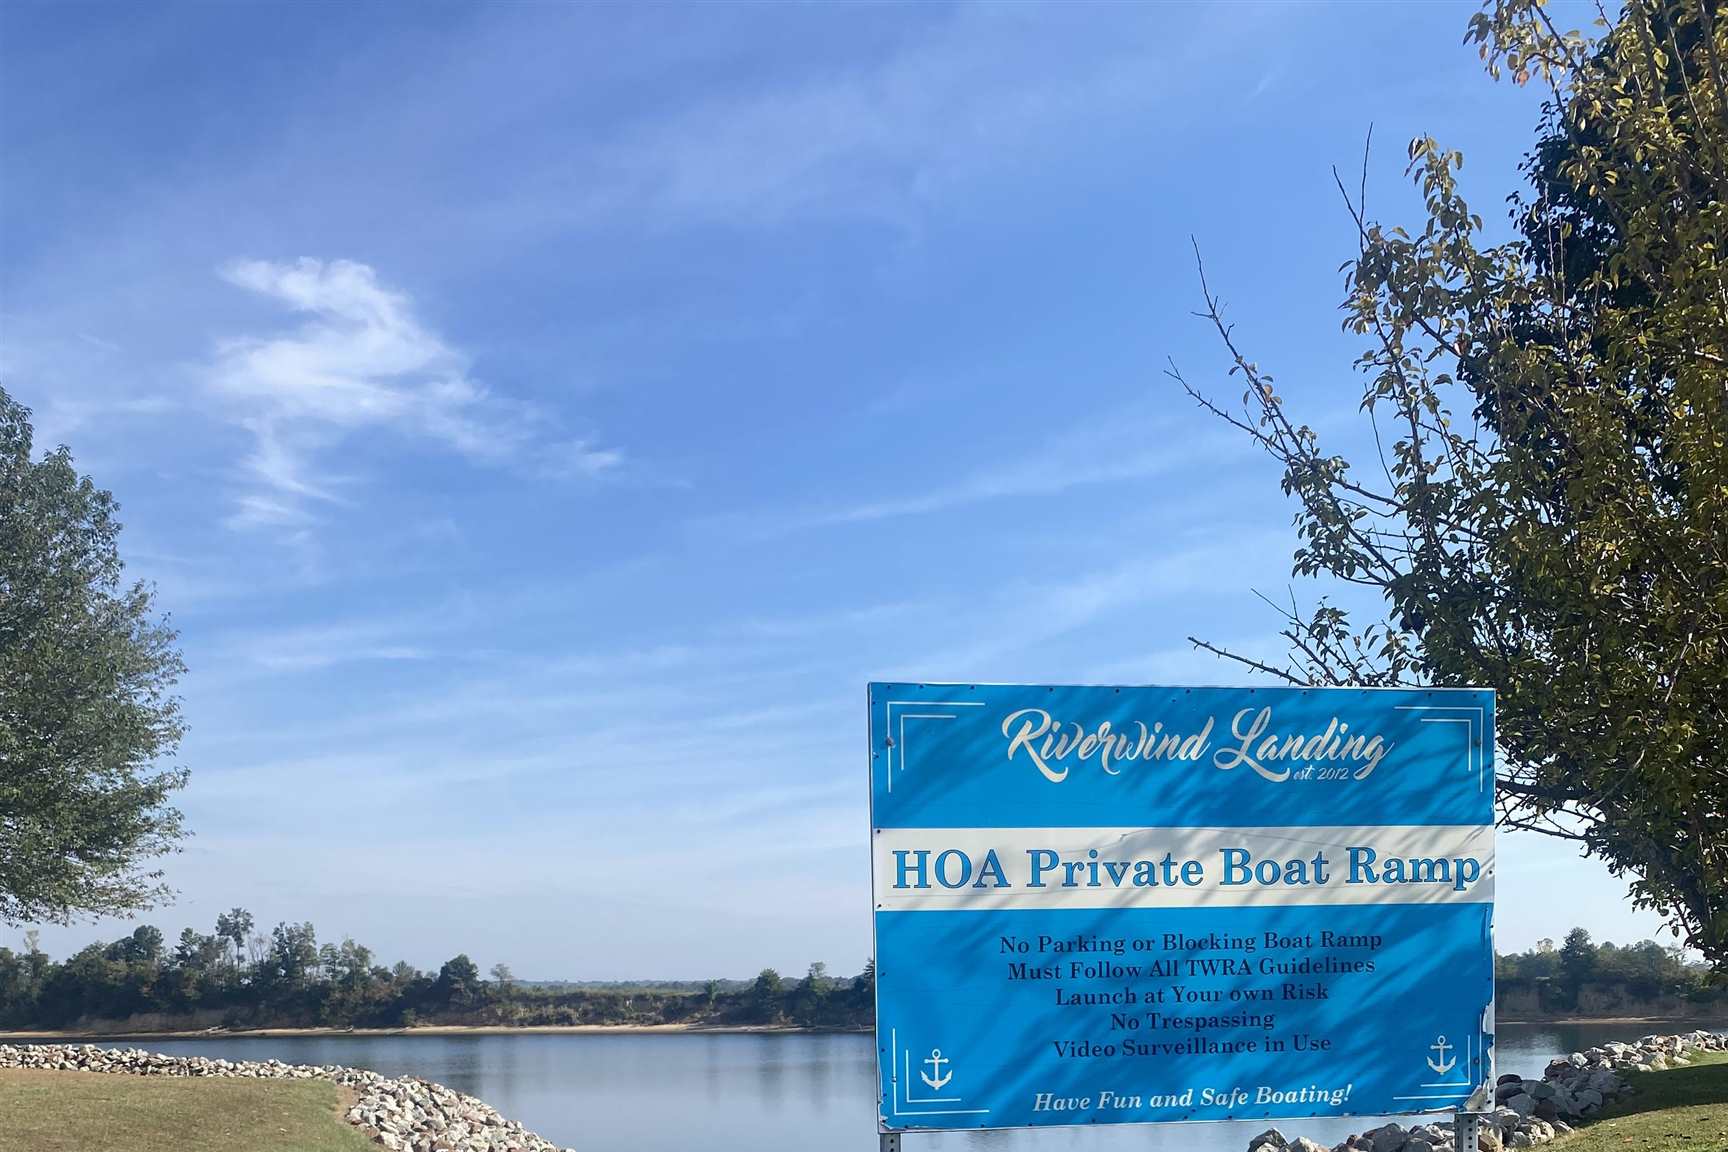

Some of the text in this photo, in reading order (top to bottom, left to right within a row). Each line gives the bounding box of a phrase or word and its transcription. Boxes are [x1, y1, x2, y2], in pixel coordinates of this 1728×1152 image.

[1001, 706, 1394, 783] Riverwind Landing
[1317, 767, 1349, 780] 2012
[892, 847, 1480, 890] HOA Private Boat Ramp
[1000, 931, 1382, 955] No Parking or Blocking Boat Ramp
[1008, 957, 1375, 979] Must Follow All TWRA Guidelines
[1056, 983, 1328, 1005] Launch at Your own Risk
[1111, 1011, 1275, 1032] No Trespassing
[1054, 1035, 1331, 1057] Video Surveillance in Use
[1034, 1084, 1352, 1112] Have Fun and Safe Boating!
